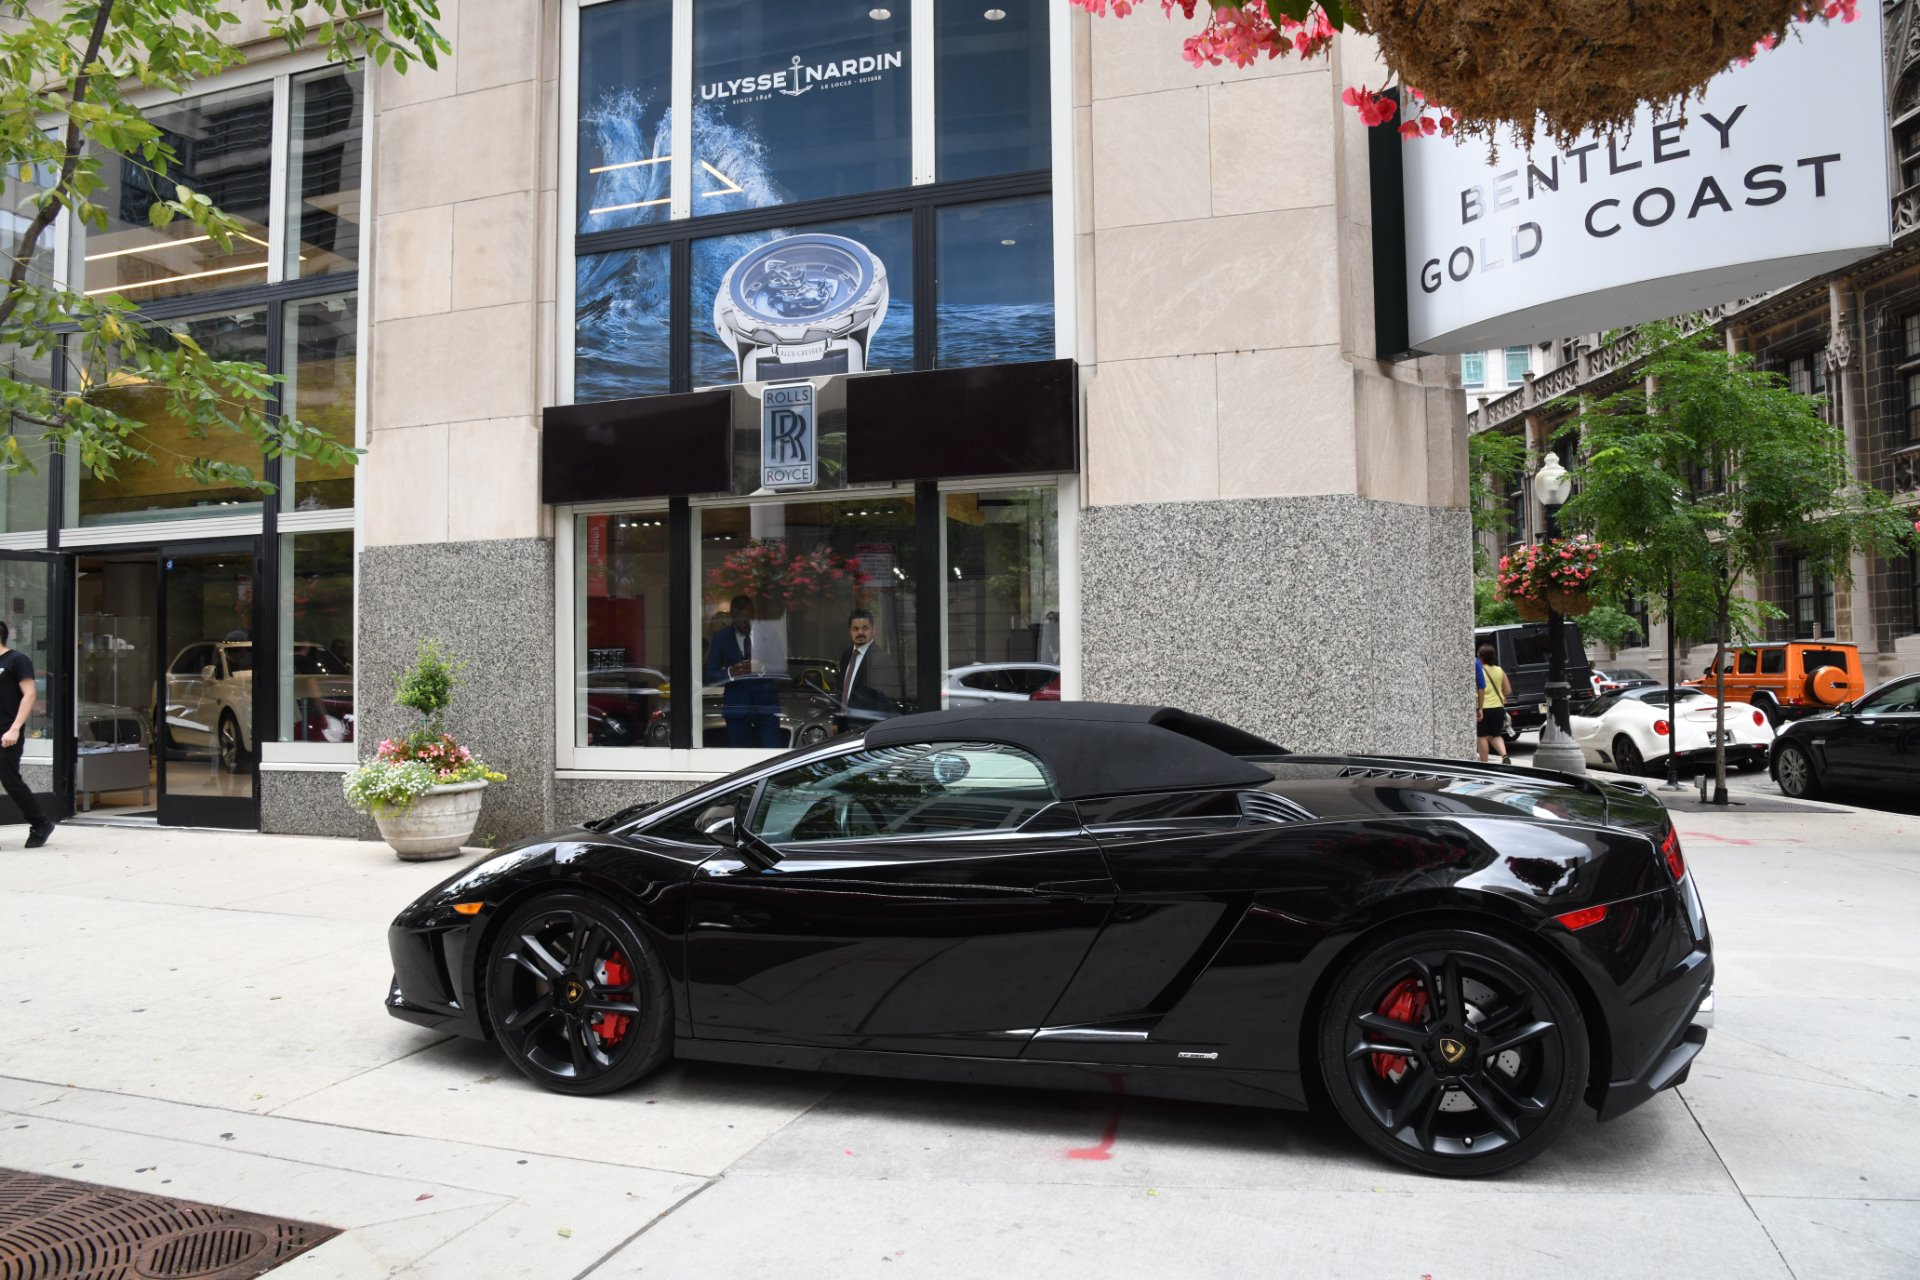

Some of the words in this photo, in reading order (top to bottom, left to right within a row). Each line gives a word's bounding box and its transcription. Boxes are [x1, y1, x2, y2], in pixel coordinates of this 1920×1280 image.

[701, 71, 787, 100] ULYSSE
[805, 51, 902, 83] NARDIN
[830, 79, 852, 88] LOCLE
[858, 74, 882, 83] SUISSE
[732, 96, 753, 105] SINCE
[1461, 104, 1748, 226] BENTLEY
[1420, 221, 1544, 295] GOLD
[1584, 153, 1842, 238] COAST
[766, 389, 809, 405] ROLLS
[766, 467, 810, 482] ROYCE
